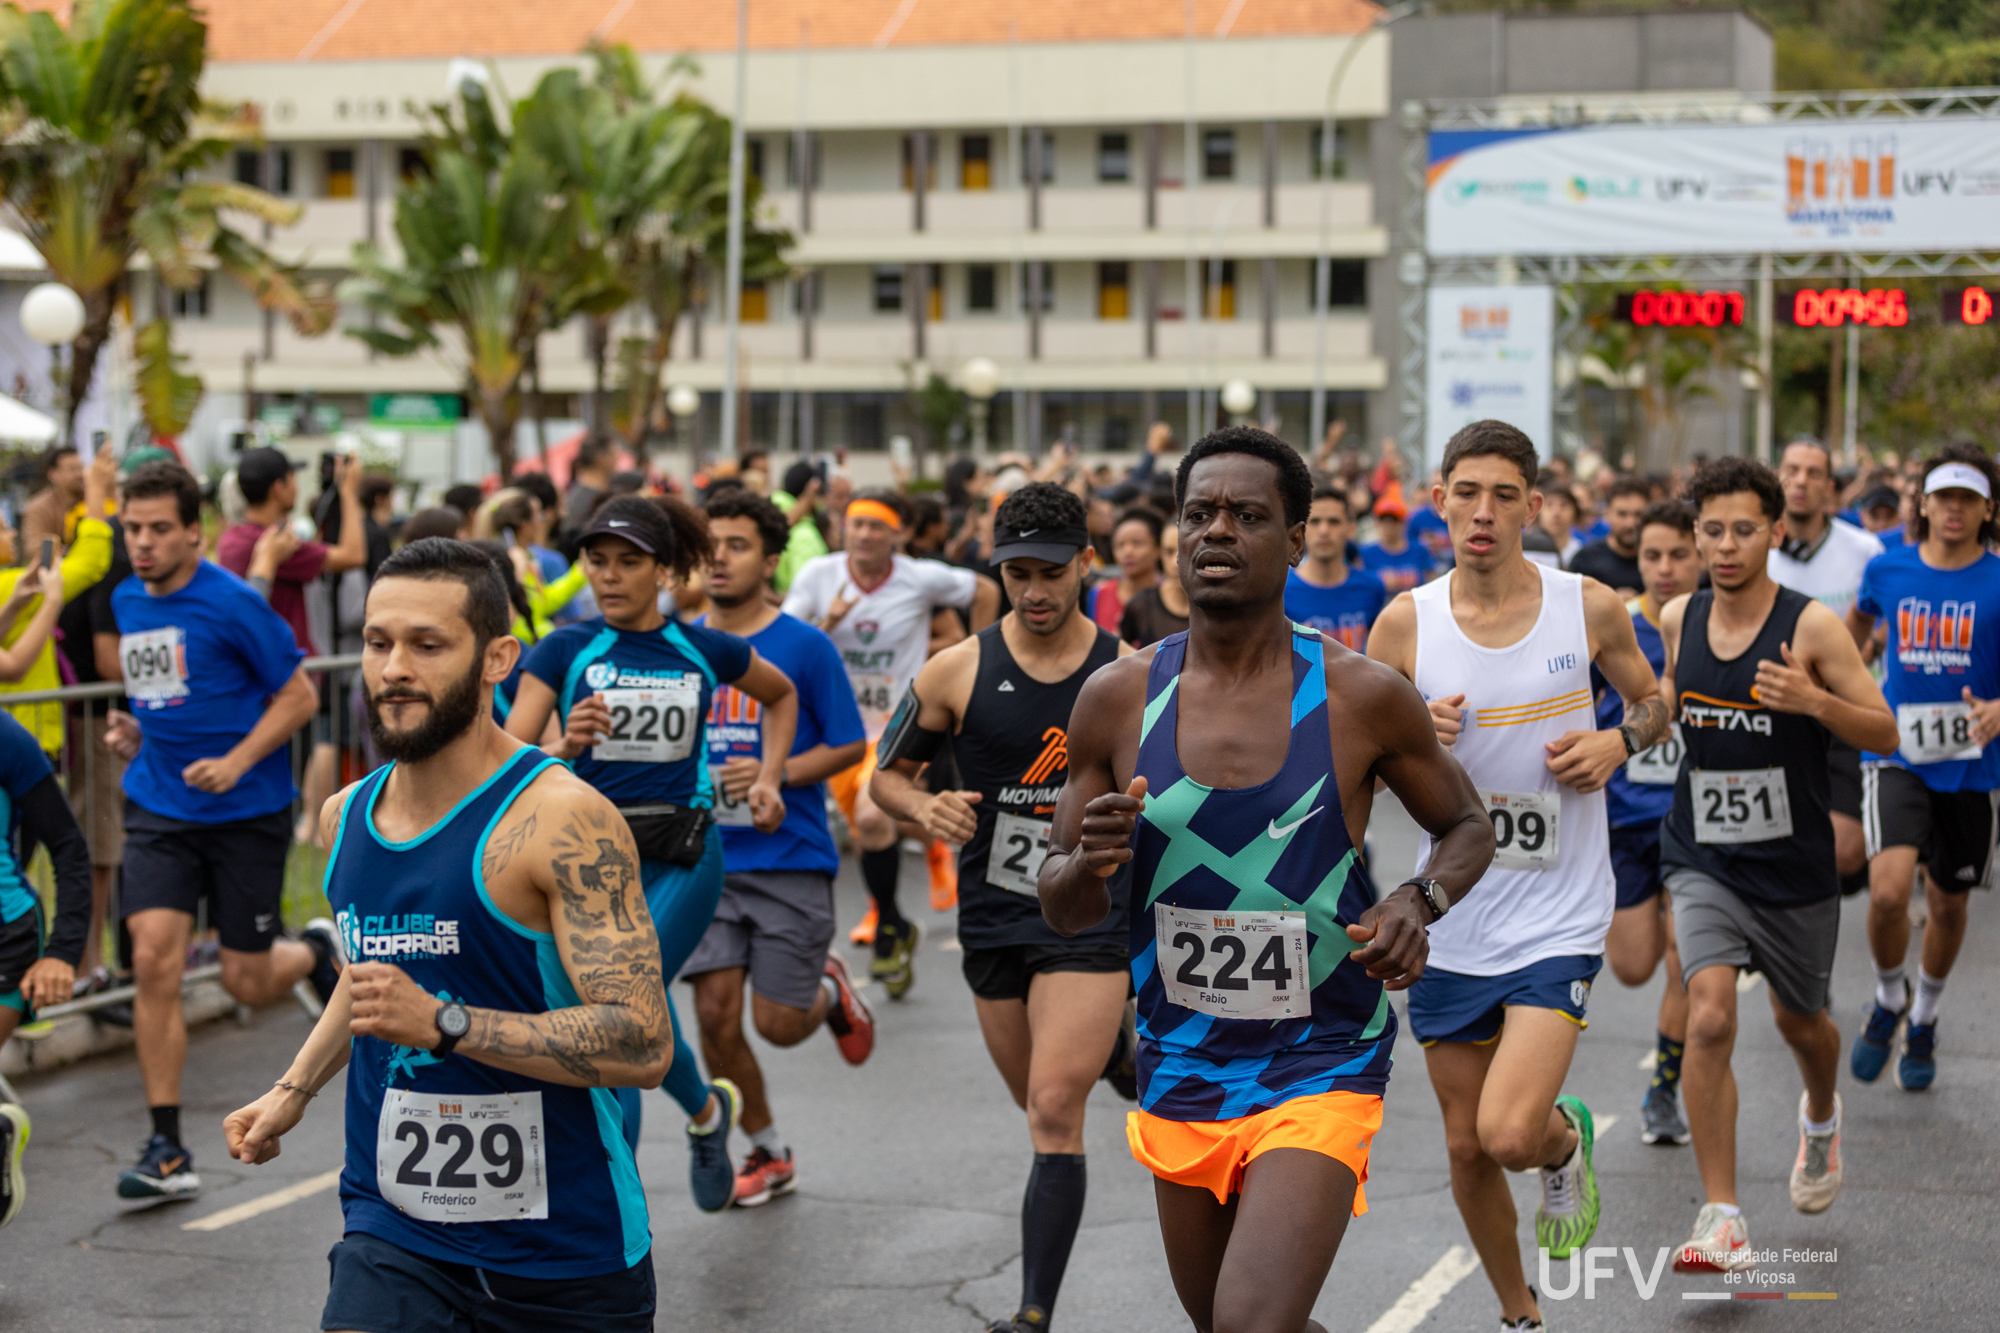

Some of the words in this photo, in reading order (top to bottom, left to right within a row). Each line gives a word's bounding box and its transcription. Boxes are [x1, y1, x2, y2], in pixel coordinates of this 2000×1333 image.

[1655, 177, 1709, 201] UFV
[1903, 168, 1955, 196] UFV
[127, 643, 172, 680] 090
[1547, 653, 1576, 674] LIVE!
[1899, 649, 1972, 668] MARATONA
[858, 686, 891, 712] 48
[608, 704, 686, 743] 220
[1909, 715, 1970, 748] 118
[1640, 737, 1680, 767] 20
[997, 787, 1062, 805] MOVIM
[1702, 786, 1774, 824] 251
[1489, 808, 1546, 852] 09
[1002, 833, 1050, 878] 27
[363, 913, 435, 935] CLUBE
[435, 920, 459, 935] DE
[1174, 920, 1189, 928] UFV
[1241, 924, 1257, 932] UFV
[362, 933, 460, 956] CORRIDA
[1172, 931, 1293, 991] 224
[1200, 991, 1227, 1004] Fabio
[400, 1107, 414, 1116] UFV
[469, 1111, 488, 1119] UFV
[530, 1125, 538, 1140] 229
[394, 1120, 525, 1189] 229
[421, 1191, 477, 1206] Frederico
[504, 1192, 524, 1200] 05KM
